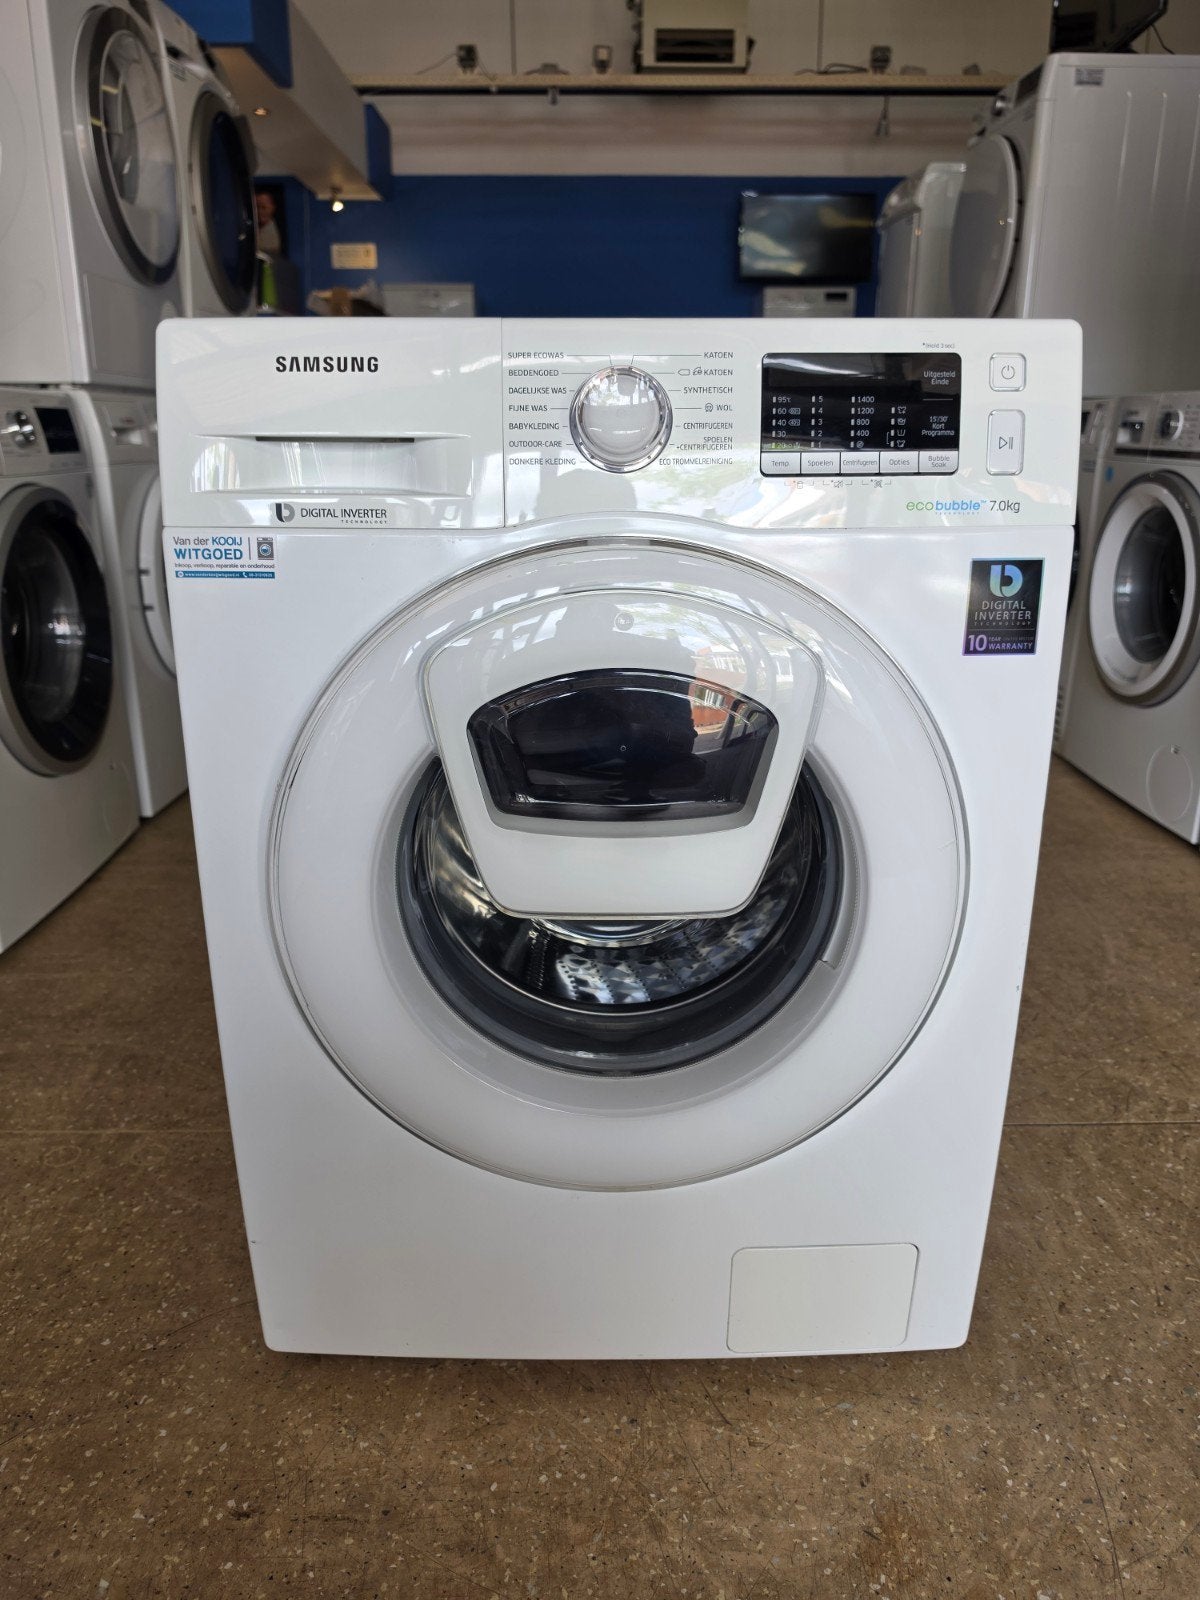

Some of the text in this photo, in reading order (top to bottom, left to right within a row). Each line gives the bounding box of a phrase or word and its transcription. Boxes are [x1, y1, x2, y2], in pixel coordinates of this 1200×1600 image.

[507, 351, 565, 359] SUPER ECOWAS
[703, 351, 734, 359] KATOEN
[275, 356, 379, 373] SAMSUNG
[508, 369, 559, 377] BEDDENGOED
[703, 368, 733, 376] KATOEN
[923, 370, 956, 379] Uitgesteld
[931, 378, 950, 386] Einde
[508, 387, 567, 395] DAGELIJKSE WAS
[683, 386, 733, 394] SYNTHETISCH
[818, 395, 824, 403] 5
[508, 404, 548, 412] FIJNE WAS
[777, 407, 787, 415] 60
[857, 407, 875, 415] 1200
[508, 422, 560, 430] BABYKLEDING
[683, 422, 733, 430] CENTRIFUGEREN
[777, 419, 787, 427] 40
[818, 418, 823, 426] 3
[855, 418, 870, 426] 800
[777, 430, 787, 438] 30
[818, 430, 823, 438] 2
[921, 429, 955, 437] Programma
[508, 440, 563, 448] OUTDOOR-CARE
[703, 436, 733, 444] SPOELEN
[509, 458, 577, 466] DONKERE KLEDING
[888, 458, 910, 467] Opties
[928, 455, 950, 463] Bubble
[771, 460, 790, 468] Temp
[807, 460, 834, 469] Spoelen
[989, 500, 1021, 514] 7.0kg
[300, 508, 387, 518] DIGITAL INVERTER
[173, 536, 243, 546] Van der KOOIJ
[174, 548, 244, 560] WITGOED
[981, 600, 1027, 610] DIGITAL
[974, 610, 1032, 621] INVERTER
[967, 634, 987, 652] 10
[988, 642, 1033, 650] WARRANTY
